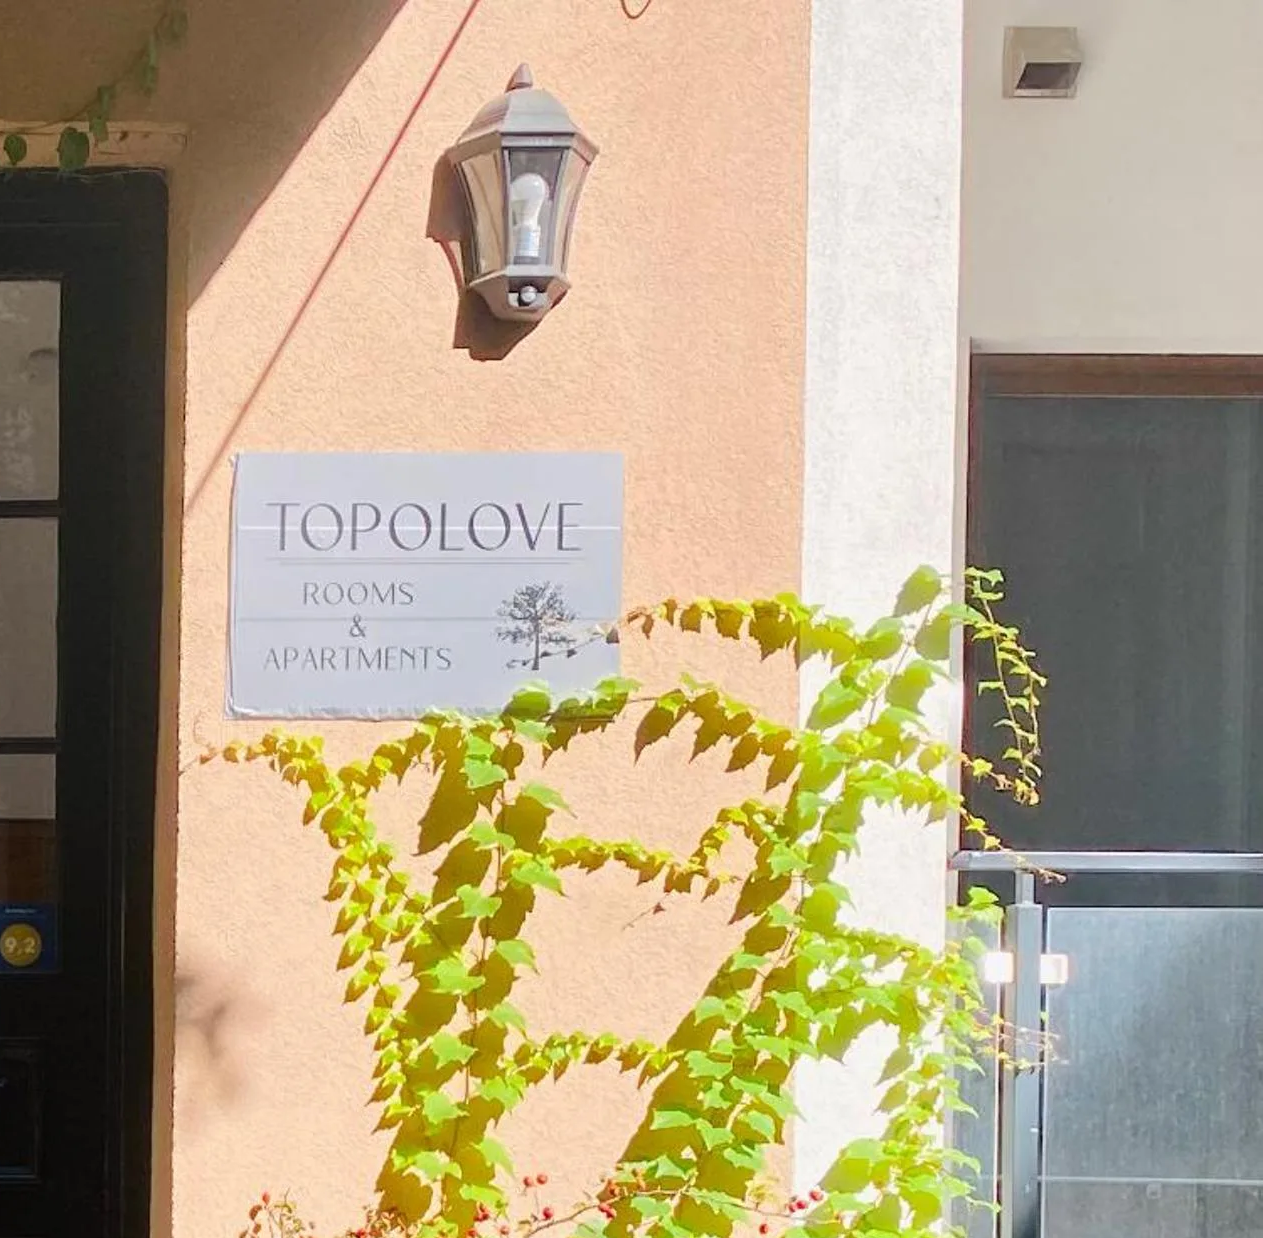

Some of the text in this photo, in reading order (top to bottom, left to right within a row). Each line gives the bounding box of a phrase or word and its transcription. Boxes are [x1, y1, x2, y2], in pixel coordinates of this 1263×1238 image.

[265, 502, 584, 552] TOPOLOVE
[302, 581, 415, 606] ROOMS
[348, 614, 367, 638] &
[263, 646, 452, 672] APARTMENTS
